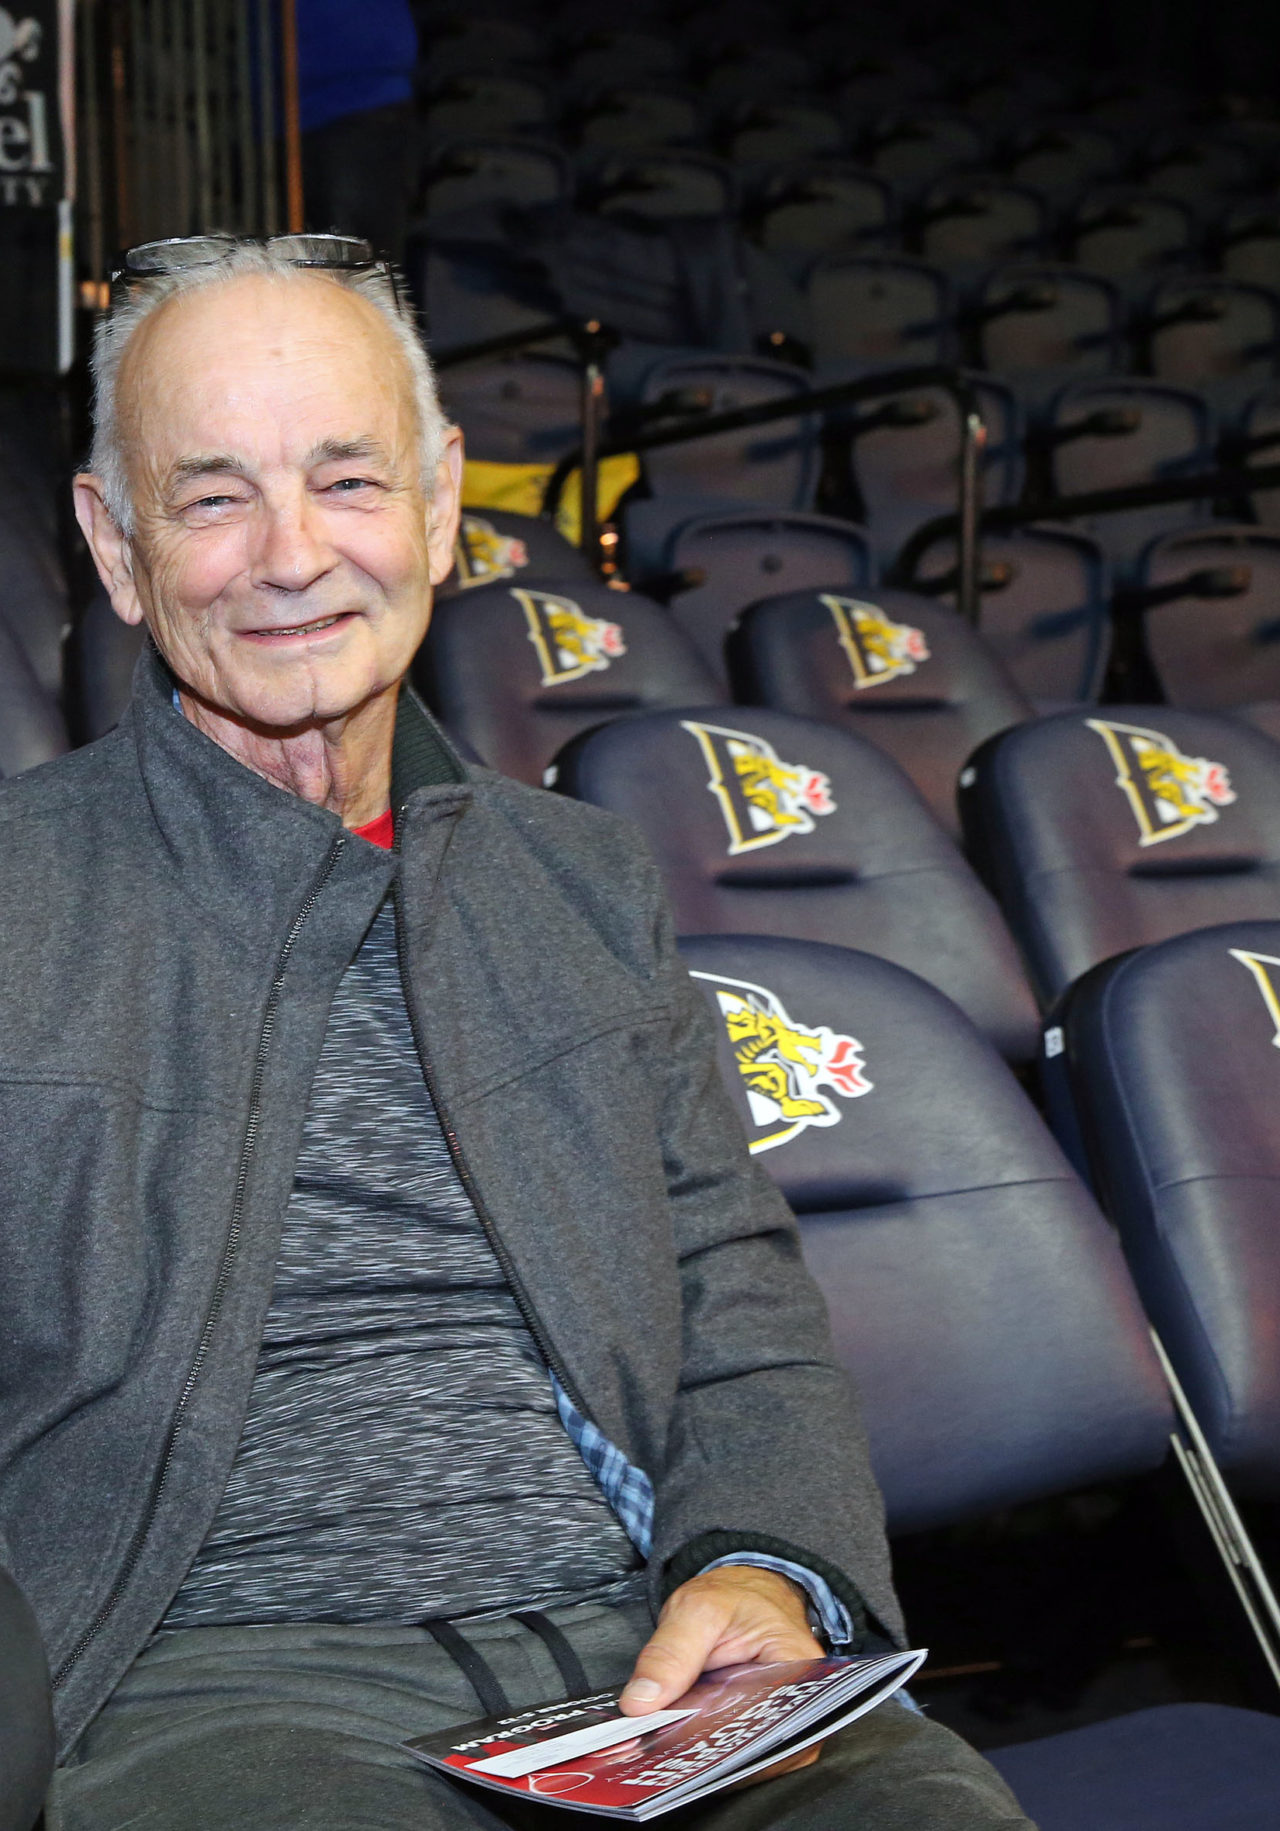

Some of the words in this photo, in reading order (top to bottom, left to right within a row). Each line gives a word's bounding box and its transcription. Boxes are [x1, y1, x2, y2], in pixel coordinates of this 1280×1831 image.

[535, 1693, 614, 1714] OCTOBER
[740, 1681, 821, 1727] U.S.
[450, 1709, 587, 1752] PROGRAM
[605, 1728, 712, 1783] UNIVERSITY
[620, 1685, 797, 1786] SQUASH
[637, 1727, 749, 1786] OPEN
